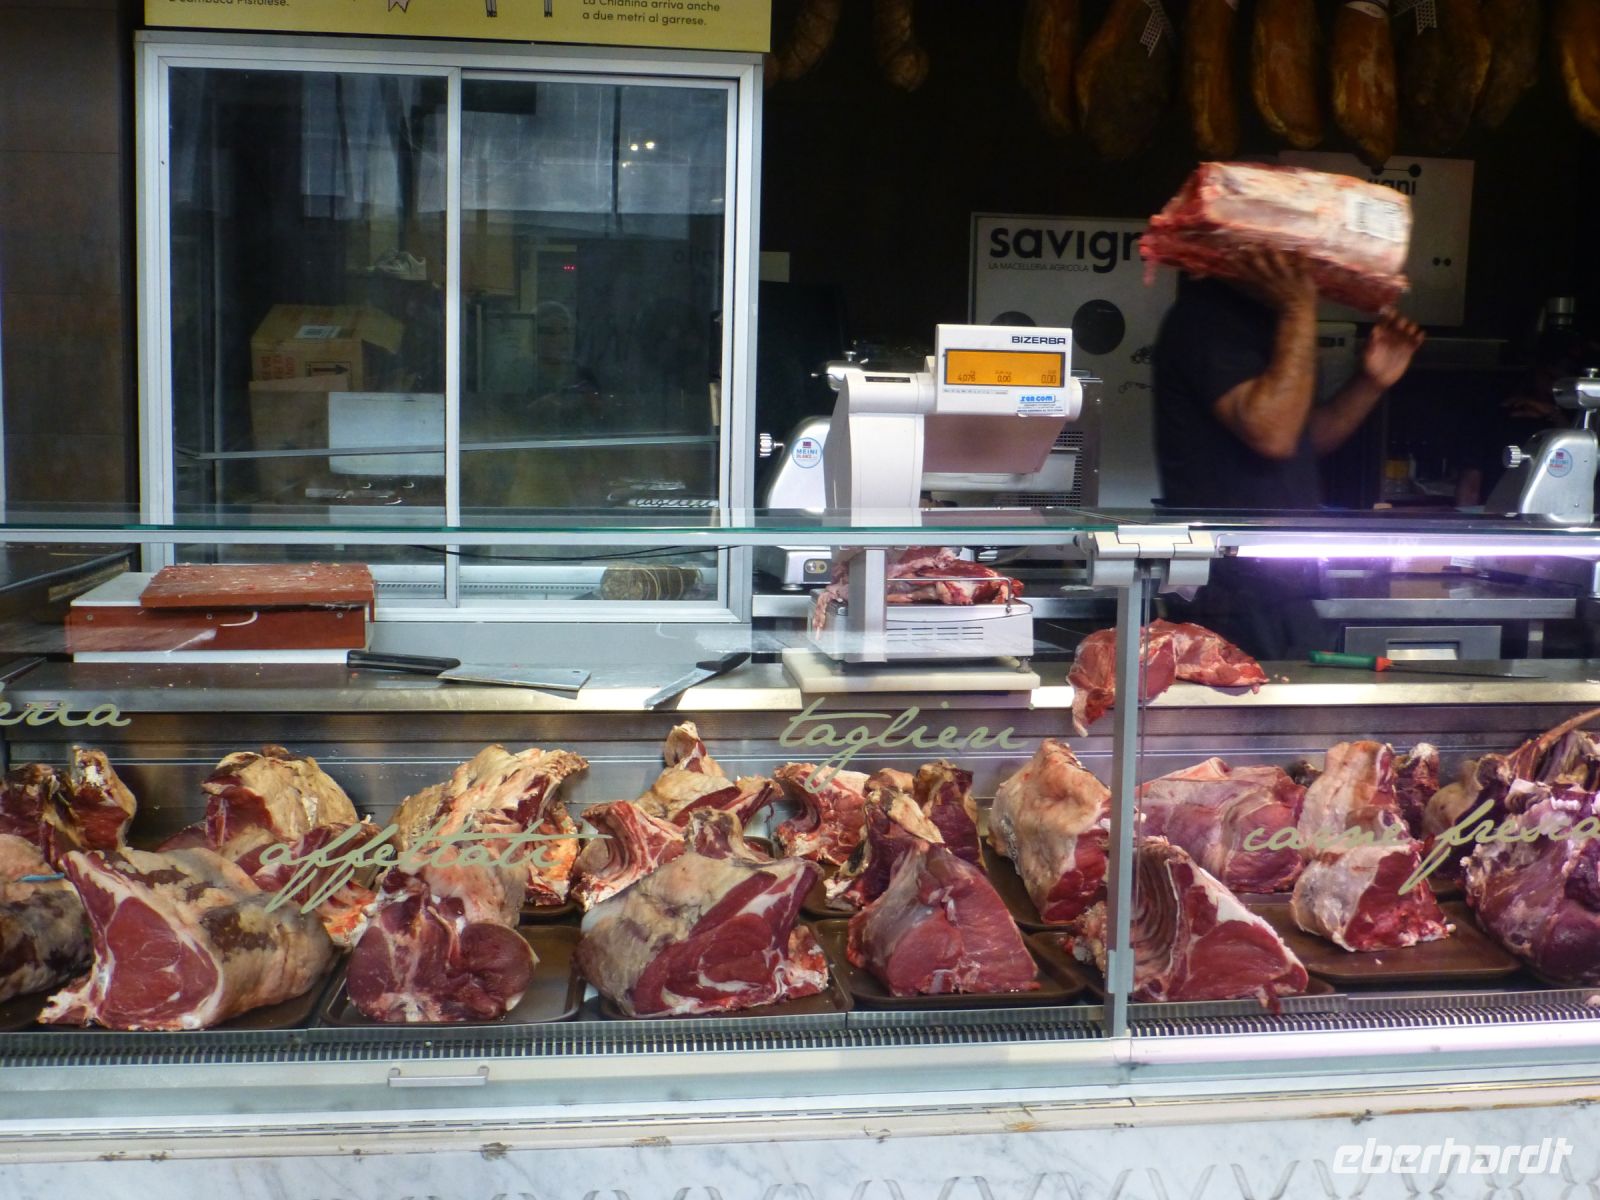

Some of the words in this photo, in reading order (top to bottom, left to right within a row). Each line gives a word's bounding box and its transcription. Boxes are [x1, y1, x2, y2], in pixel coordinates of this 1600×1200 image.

[593, 10, 614, 20] due
[617, 12, 645, 22] metri
[648, 12, 659, 22] al
[661, 15, 707, 26] garrese.
[651, 0, 684, 10] arriva
[686, 1, 720, 12] anche
[989, 227, 1143, 274] savign
[1011, 335, 1066, 345] BIZERBA
[1243, 822, 1410, 852] carne
[1398, 799, 1600, 896] fresca
[259, 817, 613, 914] affettati
